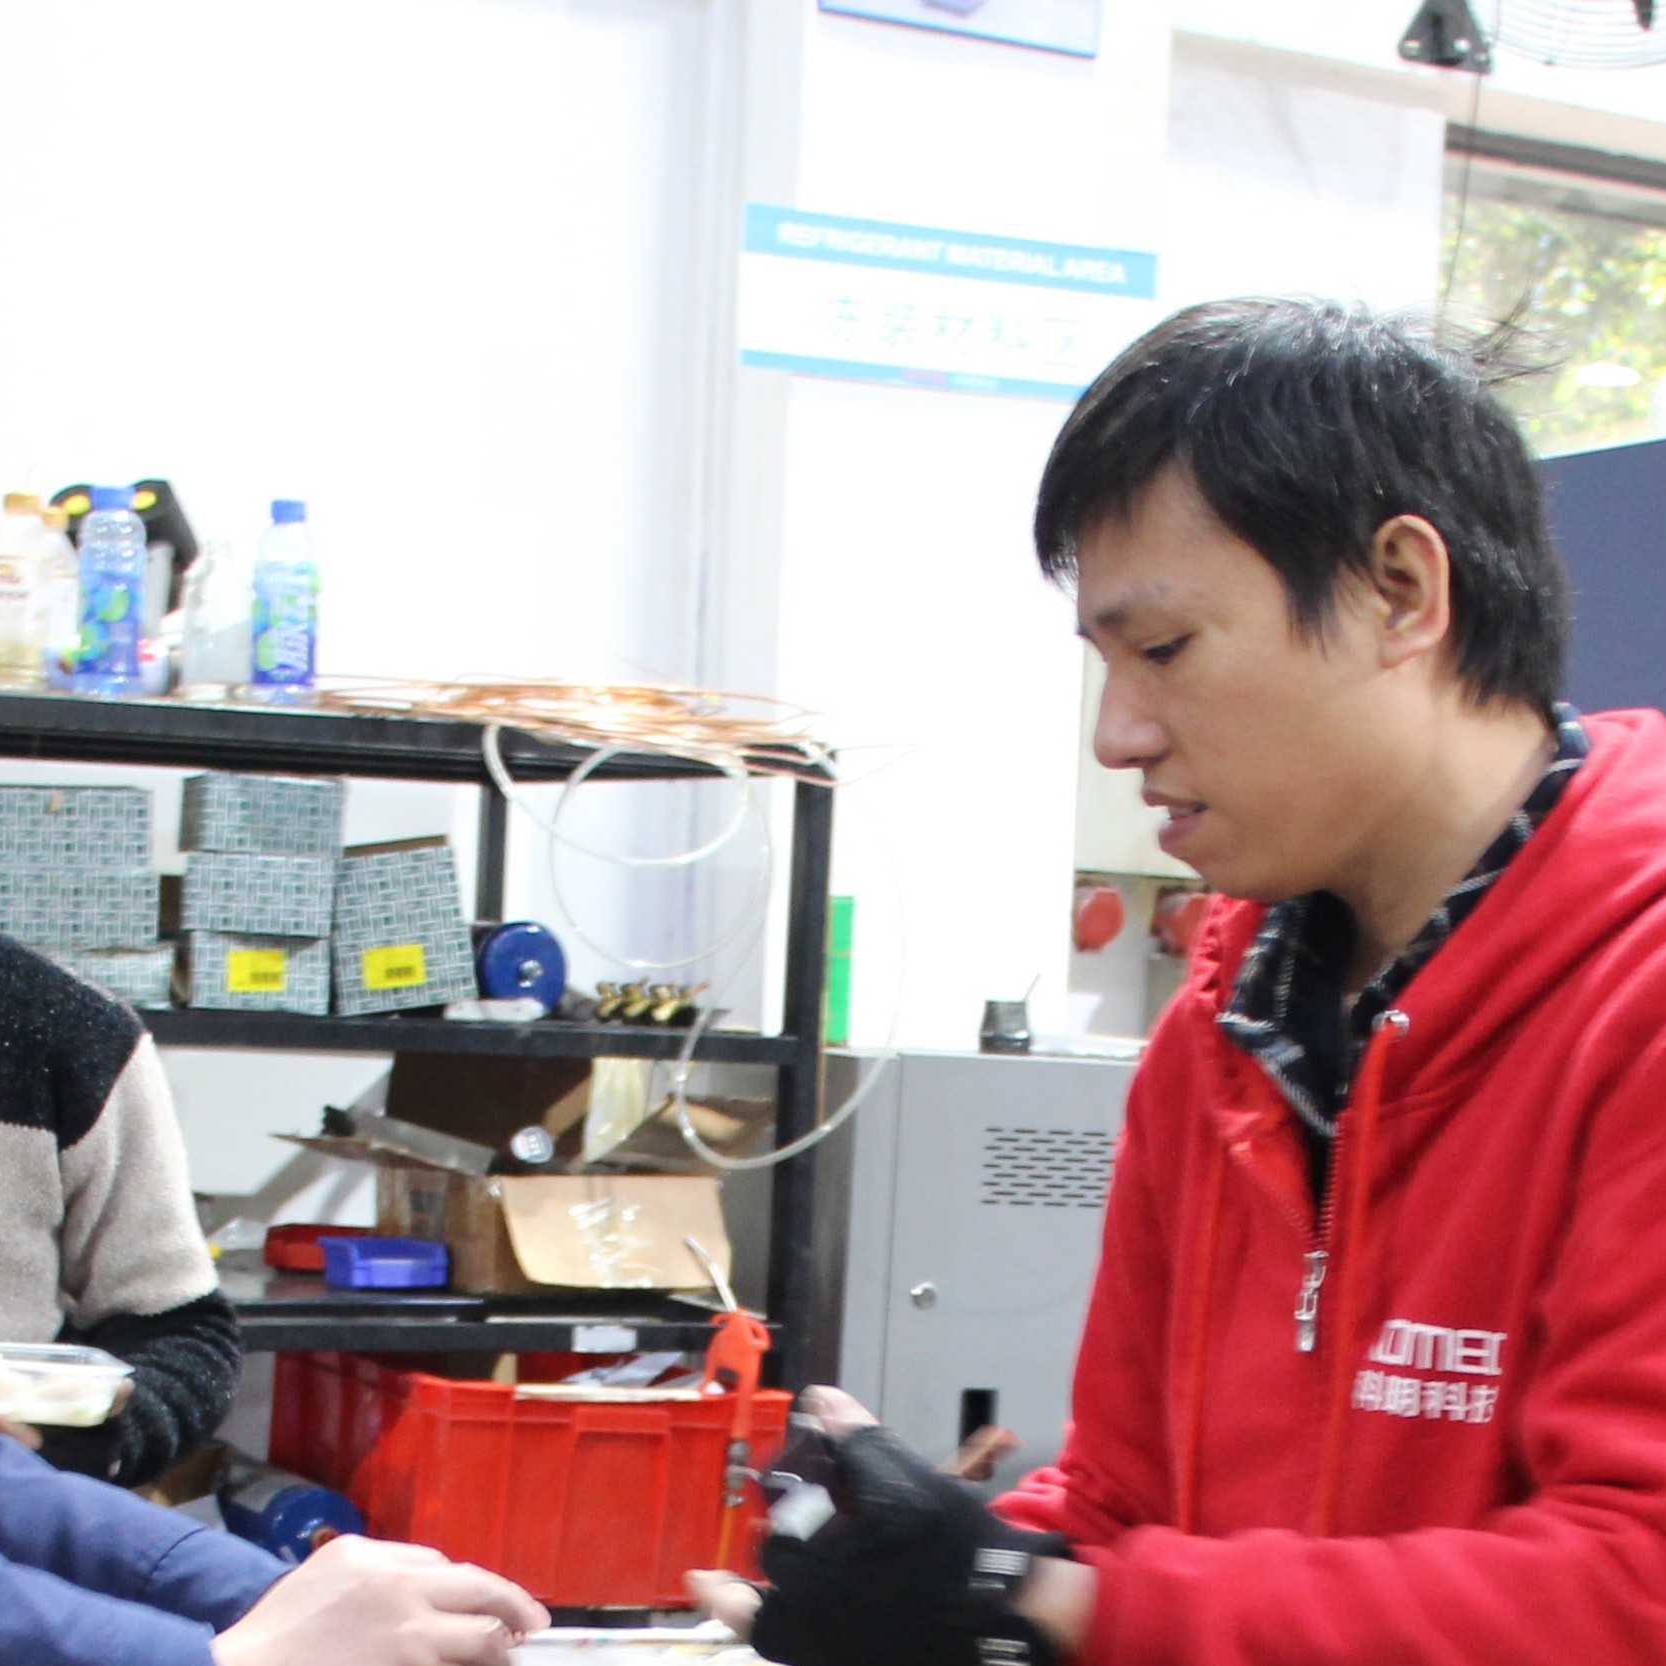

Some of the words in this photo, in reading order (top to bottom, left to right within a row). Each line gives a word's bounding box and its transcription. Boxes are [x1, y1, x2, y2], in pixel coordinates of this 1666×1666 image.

[778, 222, 942, 262] REFRIGERANT
[946, 241, 1060, 277] MATERIAL
[1062, 257, 1127, 284] AREA
